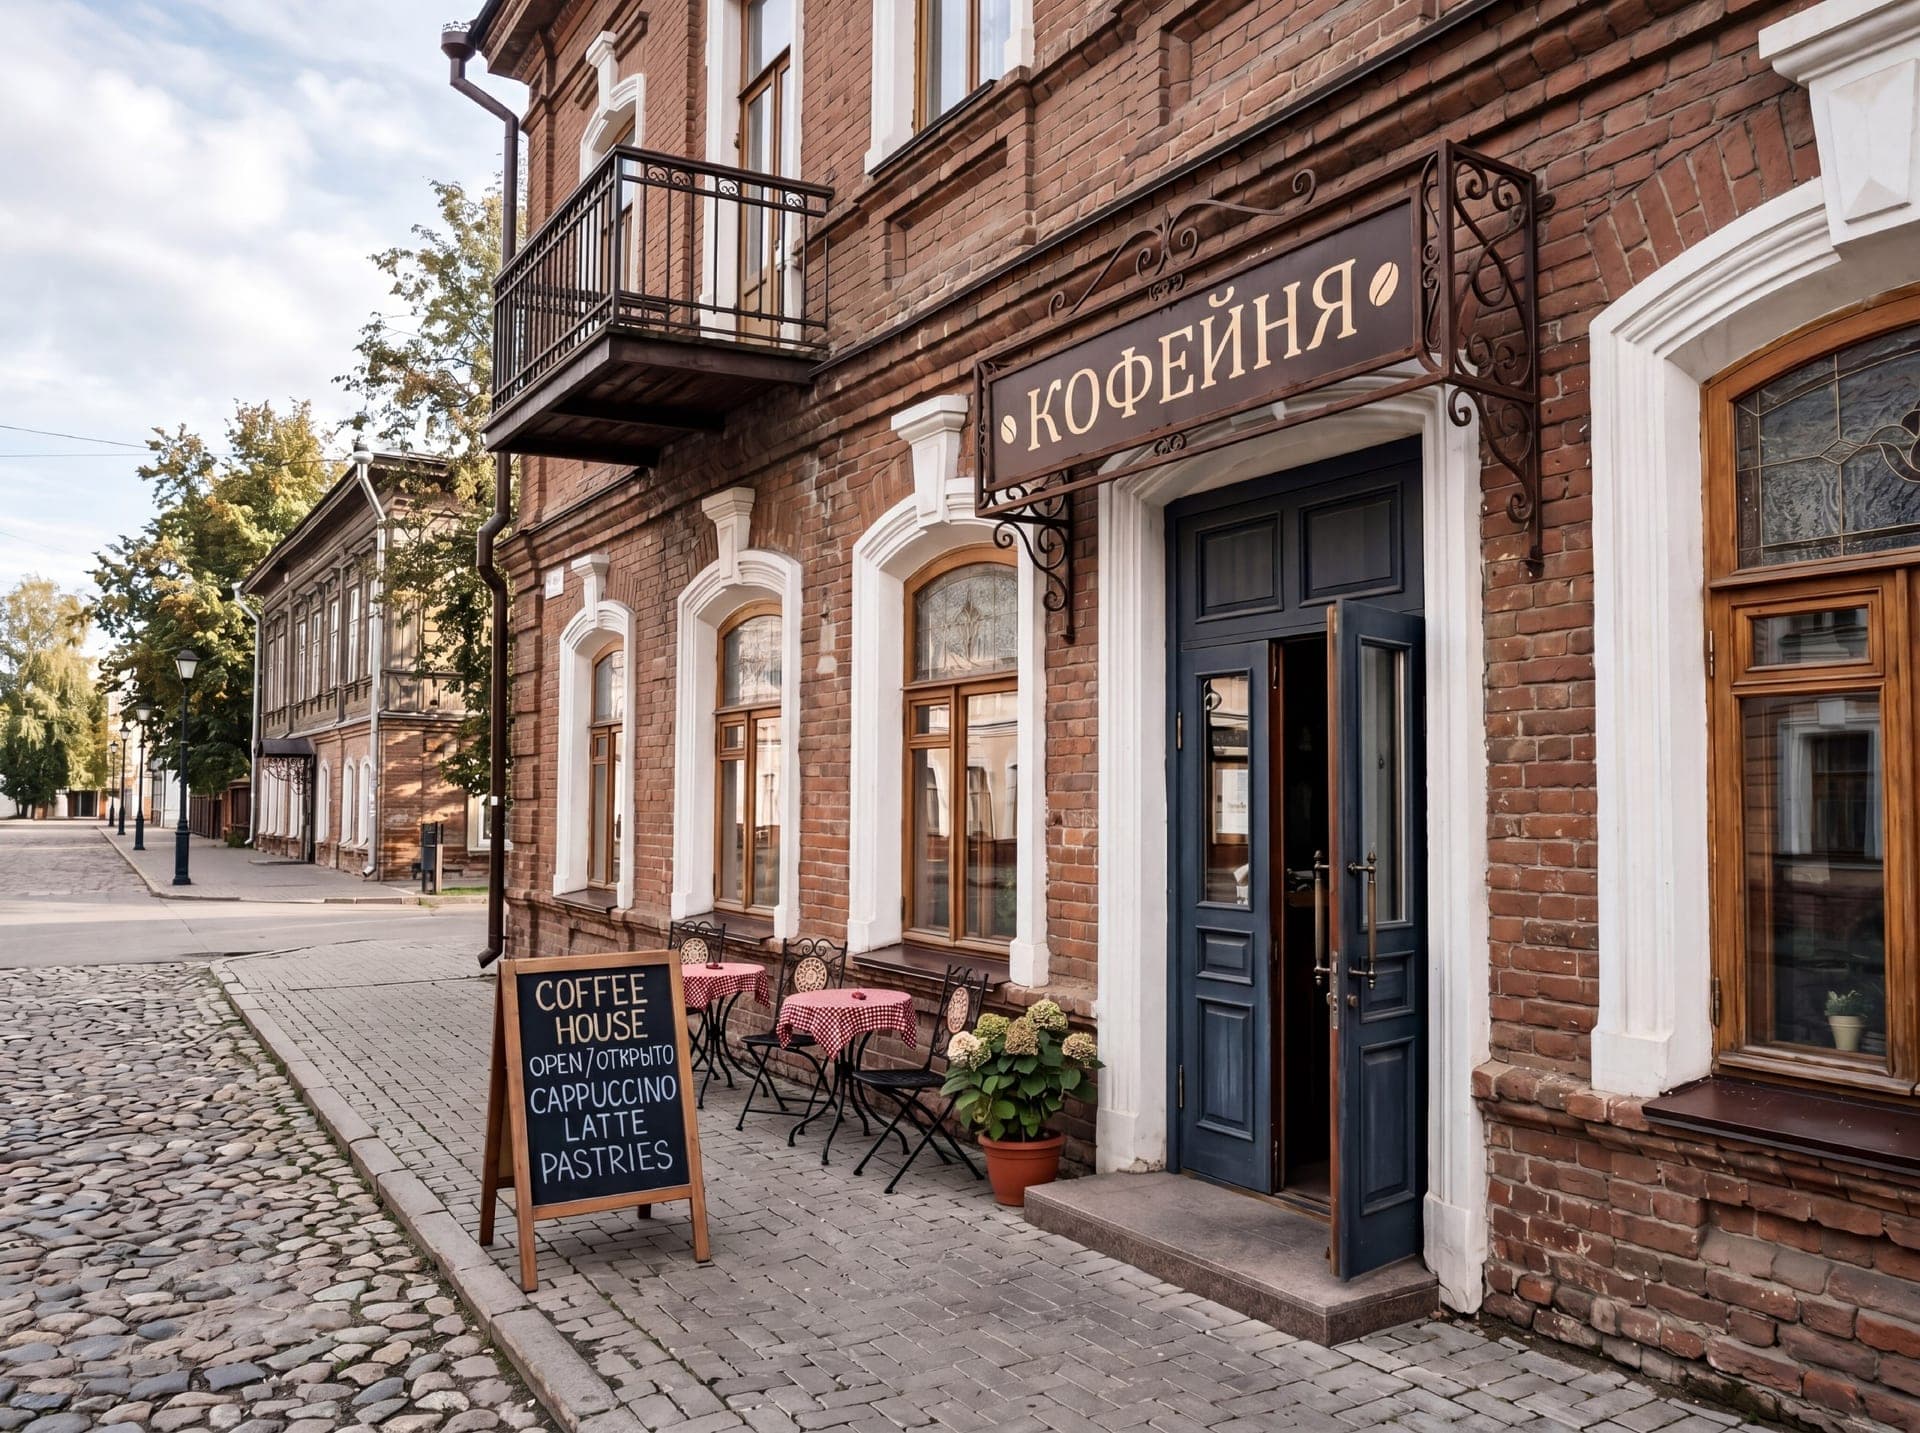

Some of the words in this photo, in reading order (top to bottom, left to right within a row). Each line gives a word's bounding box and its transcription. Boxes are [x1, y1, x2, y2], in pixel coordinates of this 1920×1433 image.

[1027, 258, 1358, 452] КОФЕЙНЯ
[535, 973, 648, 1011] COFFEE
[556, 1009, 648, 1045] HOUSE
[530, 1075, 676, 1114] CAPPUCCINO
[565, 1109, 648, 1142] LATTE
[541, 1139, 673, 1185] PASTRIES
